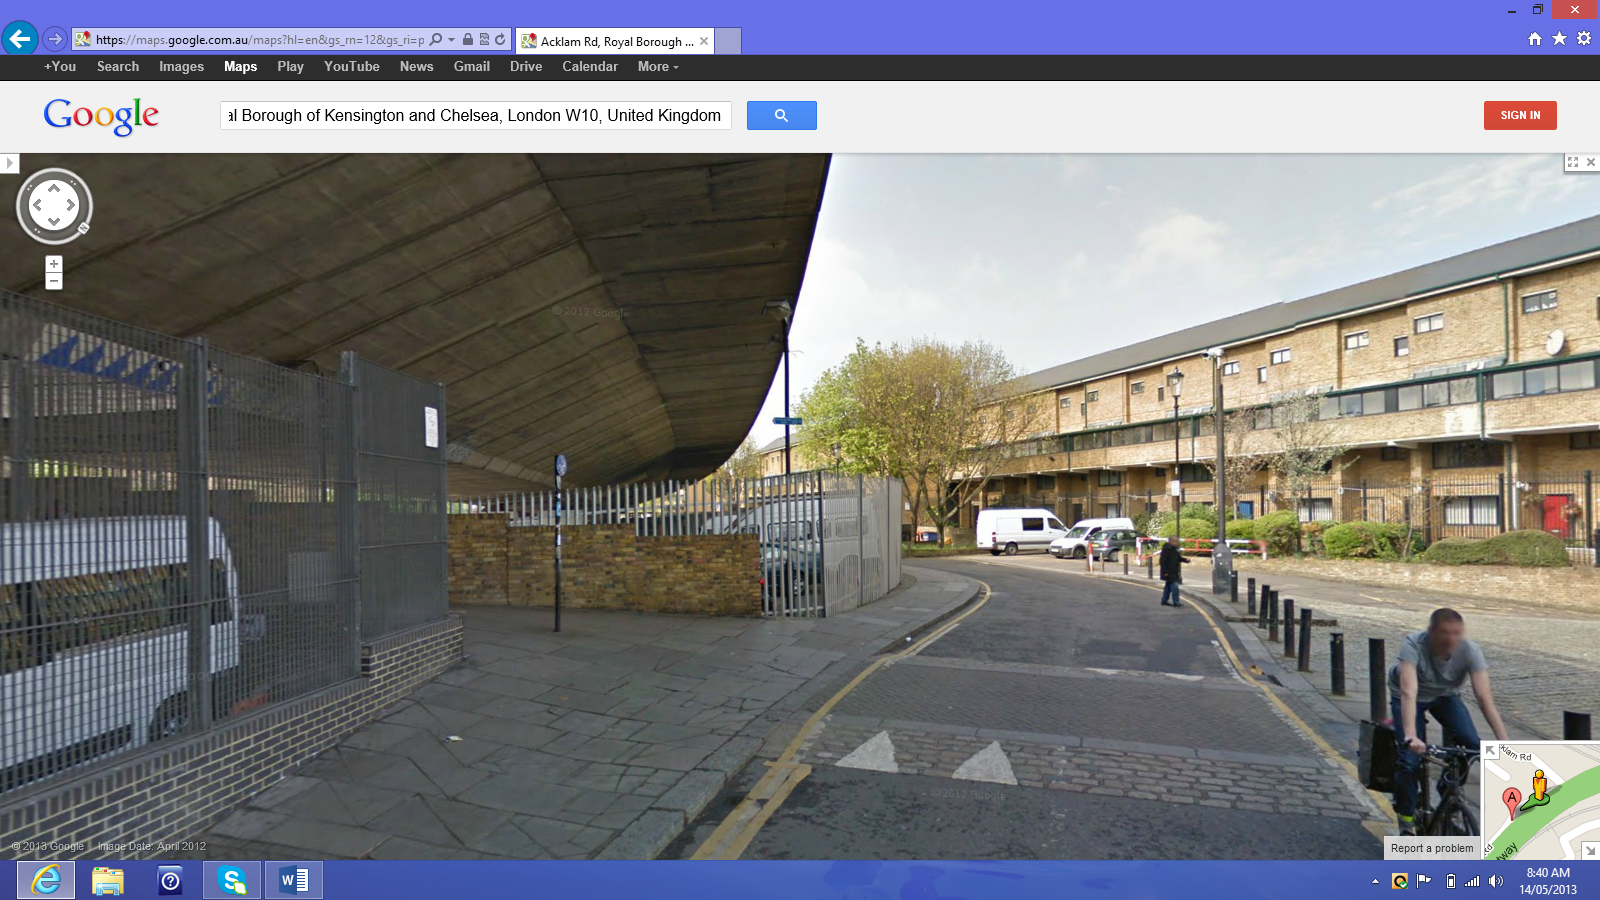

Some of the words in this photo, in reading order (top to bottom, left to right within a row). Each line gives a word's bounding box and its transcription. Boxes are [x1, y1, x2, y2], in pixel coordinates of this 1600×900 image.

[540, 36, 581, 47] Acklam
[584, 36, 601, 49] Rd,
[604, 36, 633, 50] Royal
[636, 36, 682, 50] Borough
[44, 60, 76, 72] +You
[97, 60, 140, 72] Search
[159, 60, 205, 75] Images
[224, 60, 258, 75] Maps
[277, 60, 305, 75] Play
[324, 60, 380, 72] YouTube
[400, 60, 434, 72] News
[453, 60, 490, 72] Gmail
[510, 60, 543, 72] Drive
[562, 60, 619, 72] Calendar
[638, 60, 670, 72] More
[43, 98, 159, 137] Google
[242, 108, 302, 125] Borough
[306, 108, 322, 122] of
[325, 108, 405, 125] Kensington
[409, 108, 436, 122] and
[440, 108, 503, 125] Chelsea,
[508, 108, 561, 122] London
[566, 108, 602, 125] W10,
[607, 108, 654, 122] United
[659, 108, 721, 125] Kingdom
[1500, 110, 1527, 120] SIGN
[1529, 110, 1541, 120] IN
[1500, 745, 1518, 760] klam
[1519, 753, 1532, 761] Rd
[1391, 844, 1424, 855] Report
[1426, 845, 1432, 853] a
[1435, 844, 1474, 855] problem
[1526, 867, 1549, 878] 8:40
[1551, 867, 1571, 878] AM
[1519, 884, 1578, 896] 14/05/2013
